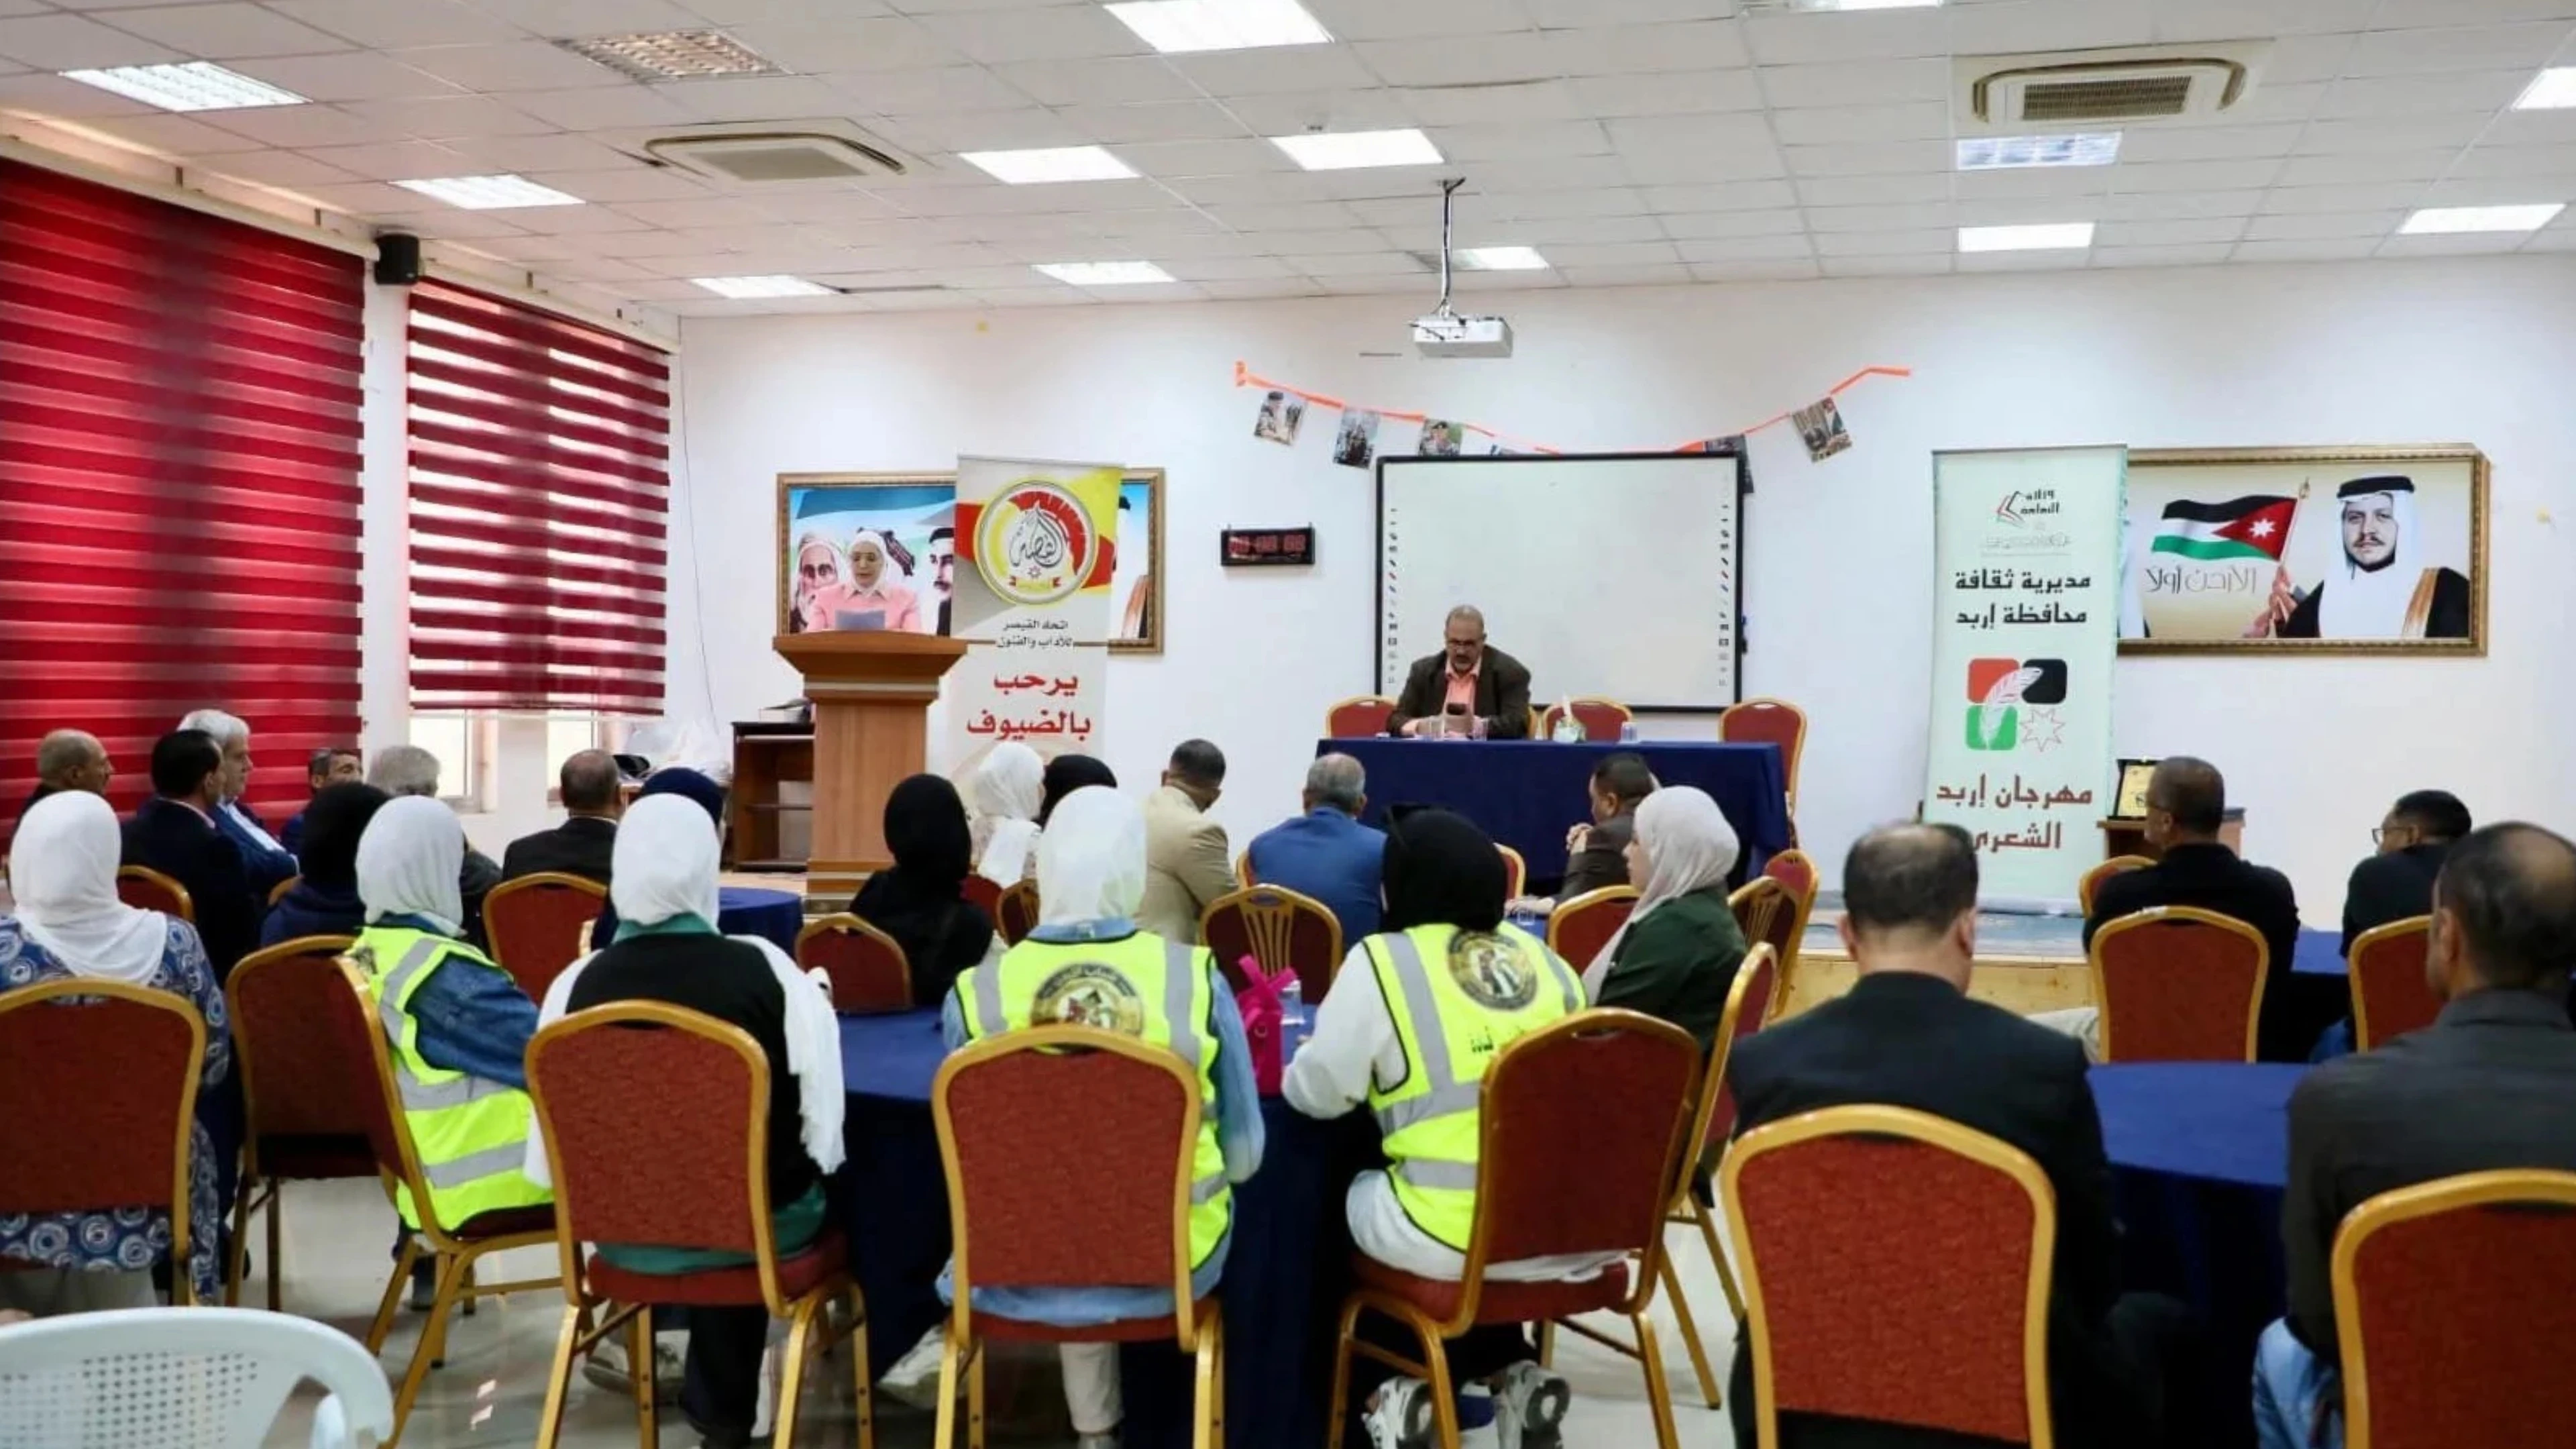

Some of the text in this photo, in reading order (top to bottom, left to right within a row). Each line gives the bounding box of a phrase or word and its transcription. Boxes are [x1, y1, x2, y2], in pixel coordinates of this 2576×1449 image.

[1955, 569, 2092, 594] مديرية ثقافة
[1955, 602, 2088, 630] محافظة إربد
[994, 672, 1079, 696] يرحب
[967, 708, 1091, 741] بالضيوف
[1936, 772, 2093, 810] مهرجان إربد
